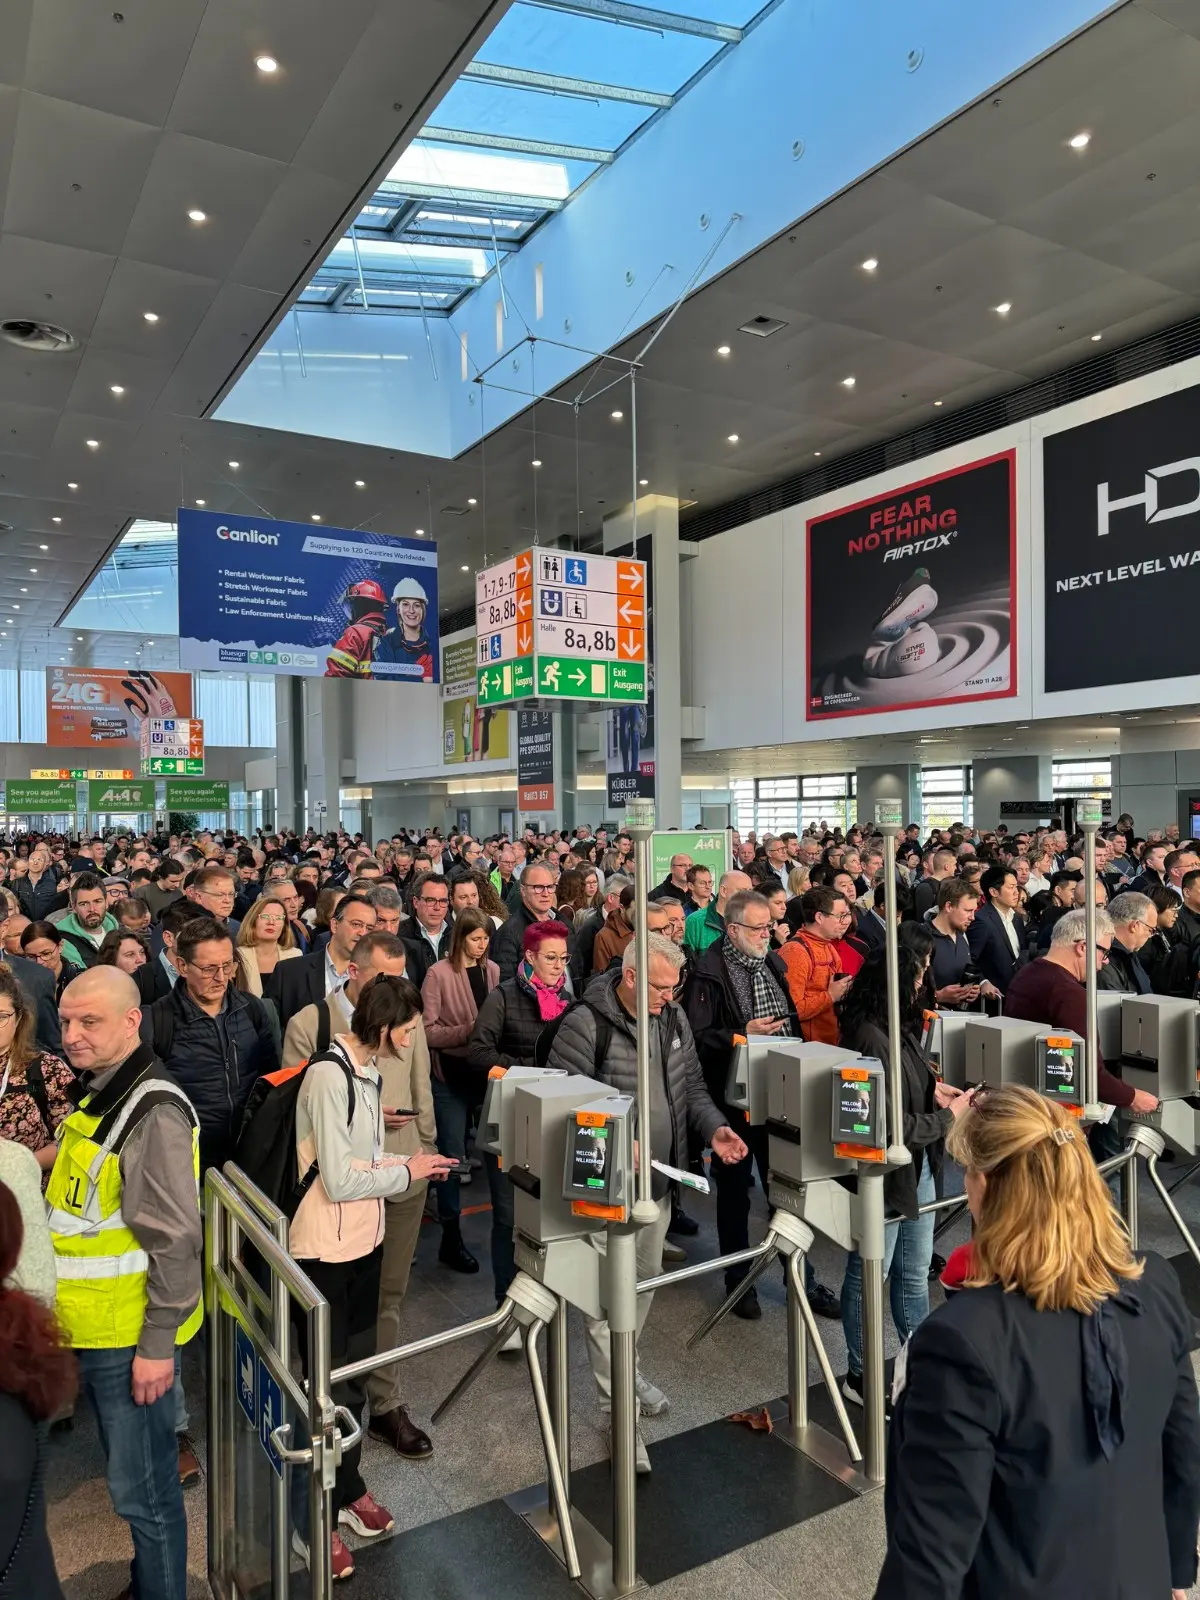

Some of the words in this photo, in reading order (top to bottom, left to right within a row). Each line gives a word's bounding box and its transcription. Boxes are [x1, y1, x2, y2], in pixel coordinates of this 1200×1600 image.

[870, 494, 931, 530] FEAR
[216, 525, 279, 546] Canlion
[848, 508, 957, 556] NOTHING
[309, 541, 341, 553] Supplying
[394, 551, 426, 562] Worldwide
[224, 569, 247, 578] Rental
[248, 572, 283, 582] Workwear
[284, 575, 305, 585] Fabric
[1056, 571, 1103, 593] NEXT
[1107, 558, 1166, 582] LEVEL
[224, 582, 250, 591] Stretch
[251, 584, 286, 594] Workwear
[287, 588, 308, 597] Fabric
[224, 594, 265, 605] Sustainable
[266, 598, 287, 607] Fabric
[225, 607, 239, 615] Law
[241, 608, 285, 619] Enforcement
[489, 597, 516, 625] 8a,8b
[540, 623, 557, 632] Halle
[564, 627, 616, 653] 8a,8b
[515, 665, 523, 675] Exit
[613, 668, 627, 677] Exit
[515, 676, 533, 687] Ausgang
[613, 679, 643, 692] Ausgang
[964, 678, 984, 687] STAND
[51, 682, 105, 704] 24G
[520, 734, 534, 745] GLOBAL
[534, 732, 551, 744] QUALITY
[520, 746, 528, 755] PPE
[528, 743, 551, 754] SPECIALIST
[642, 764, 654, 773] NEU
[611, 777, 637, 790] KÜBLER
[10, 788, 25, 796] See
[26, 789, 39, 798] you
[40, 789, 60, 797] again
[99, 789, 130, 802] A+A
[183, 789, 196, 797] you
[197, 789, 215, 797] again
[693, 838, 714, 850] A+A
